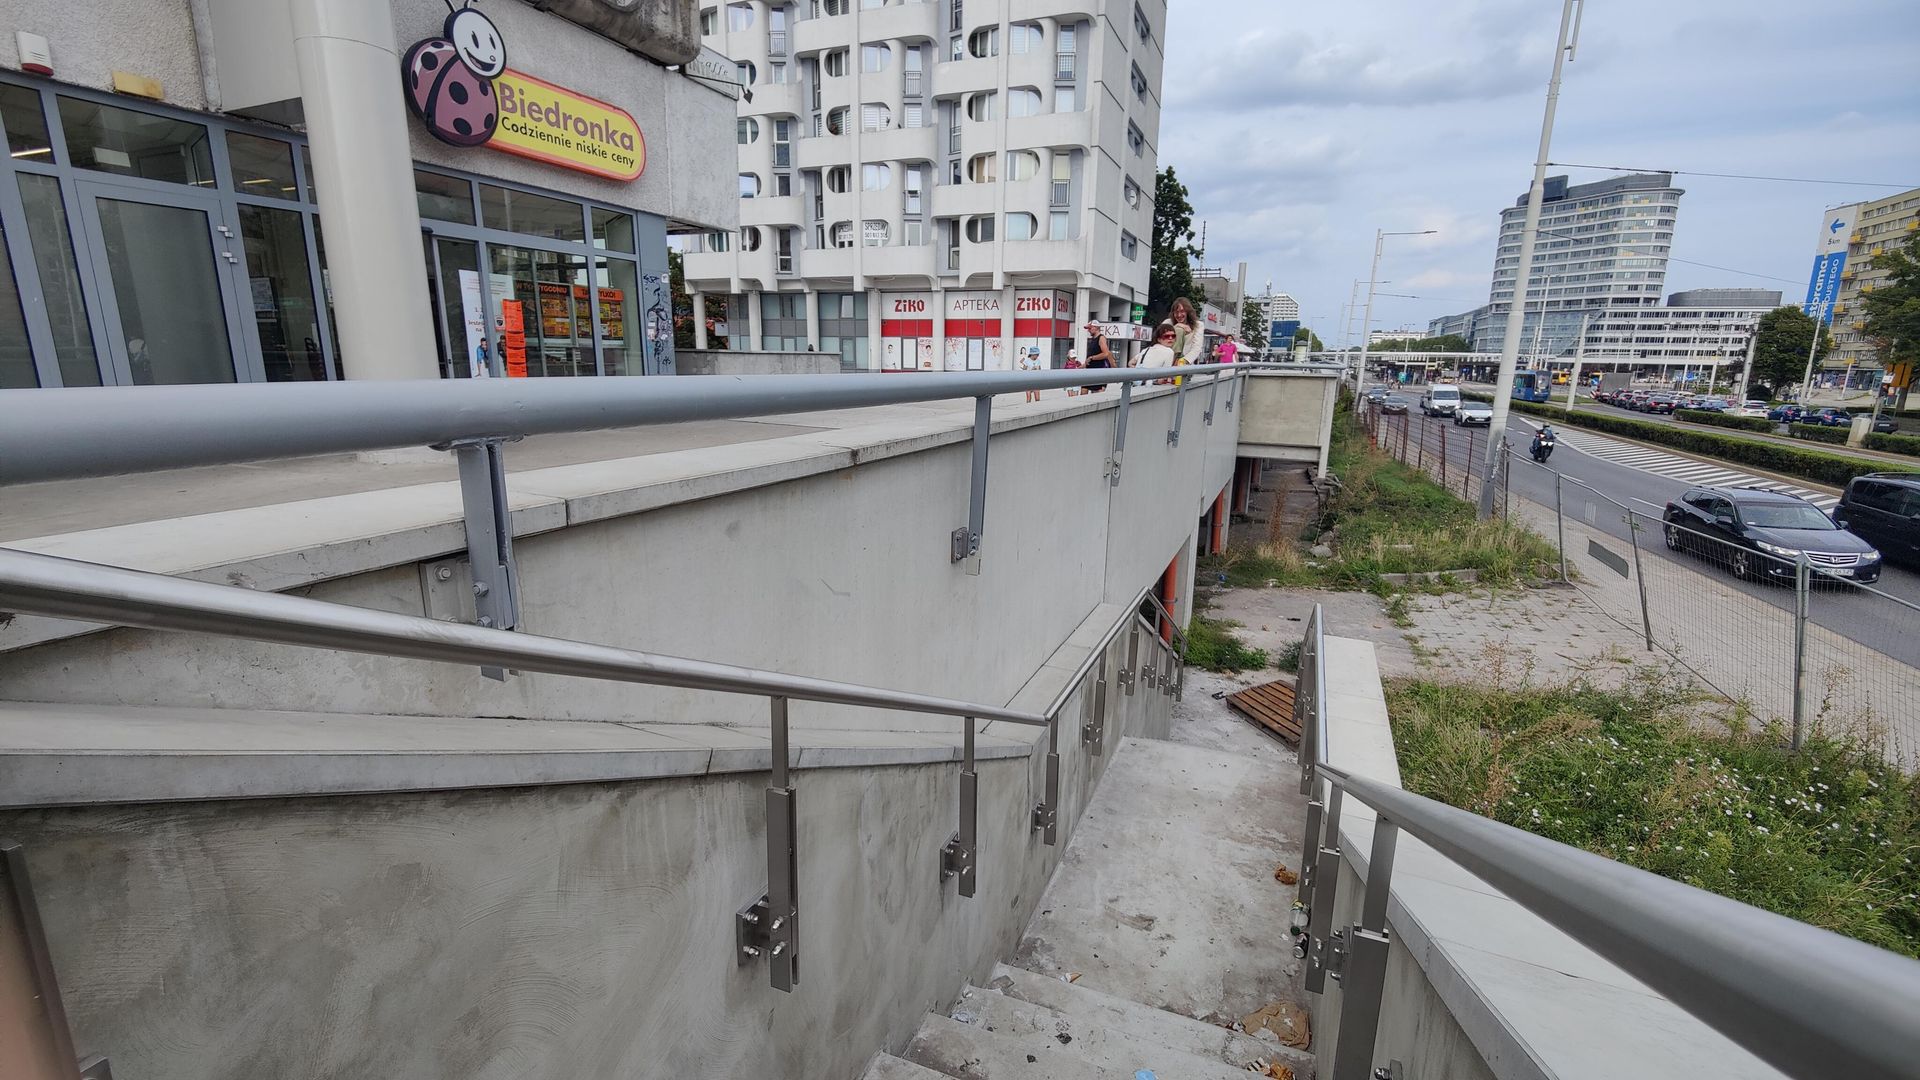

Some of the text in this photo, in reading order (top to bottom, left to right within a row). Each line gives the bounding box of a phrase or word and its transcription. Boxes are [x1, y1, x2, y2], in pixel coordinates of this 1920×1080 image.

[499, 81, 635, 152] Biedronka
[501, 116, 635, 169] Codziennie niskie ceny
[953, 299, 1000, 311] APTEKA
[1808, 257, 1829, 318] storama
[1099, 325, 1121, 336] EKA
